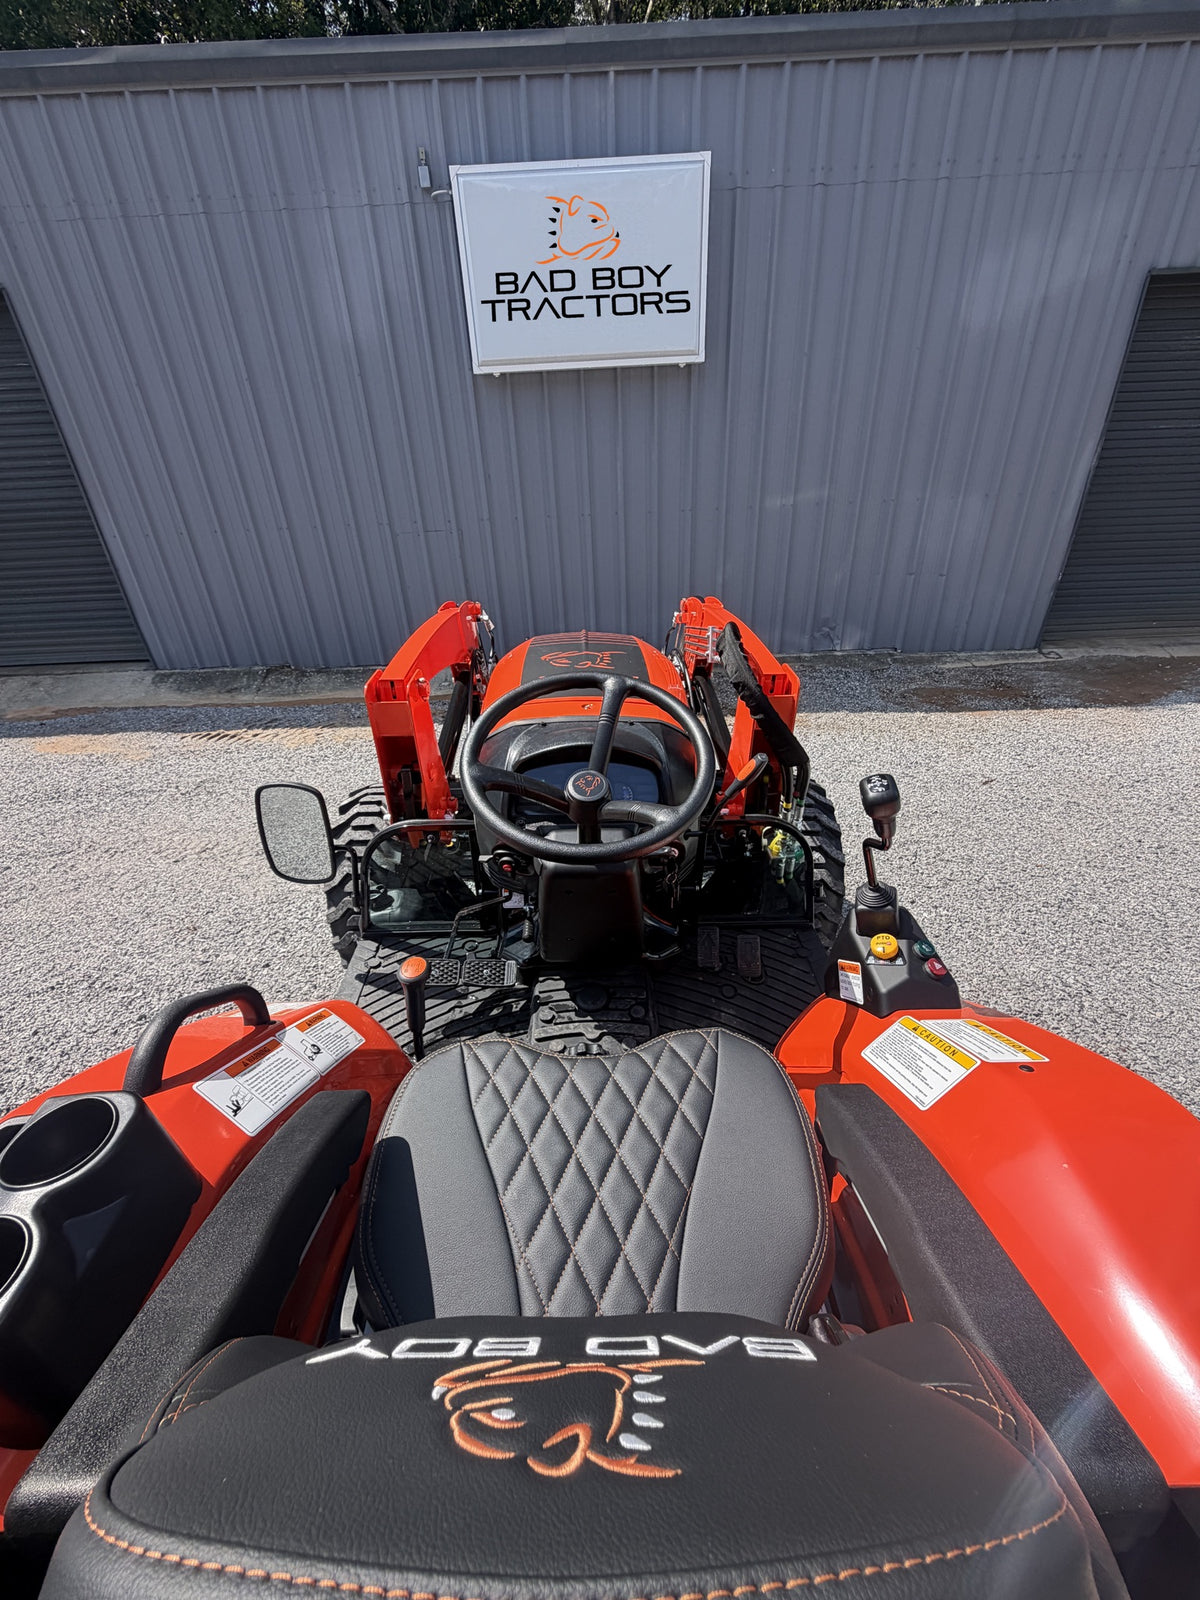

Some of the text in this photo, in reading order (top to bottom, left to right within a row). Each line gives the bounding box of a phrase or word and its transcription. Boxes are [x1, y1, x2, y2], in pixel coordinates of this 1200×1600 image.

[495, 264, 672, 295] BAD BOY
[481, 290, 691, 322] TRACTORS
[246, 1046, 271, 1063] WARNING
[919, 1029, 959, 1057] CAUTION
[305, 1335, 818, 1365] BAD BOY
